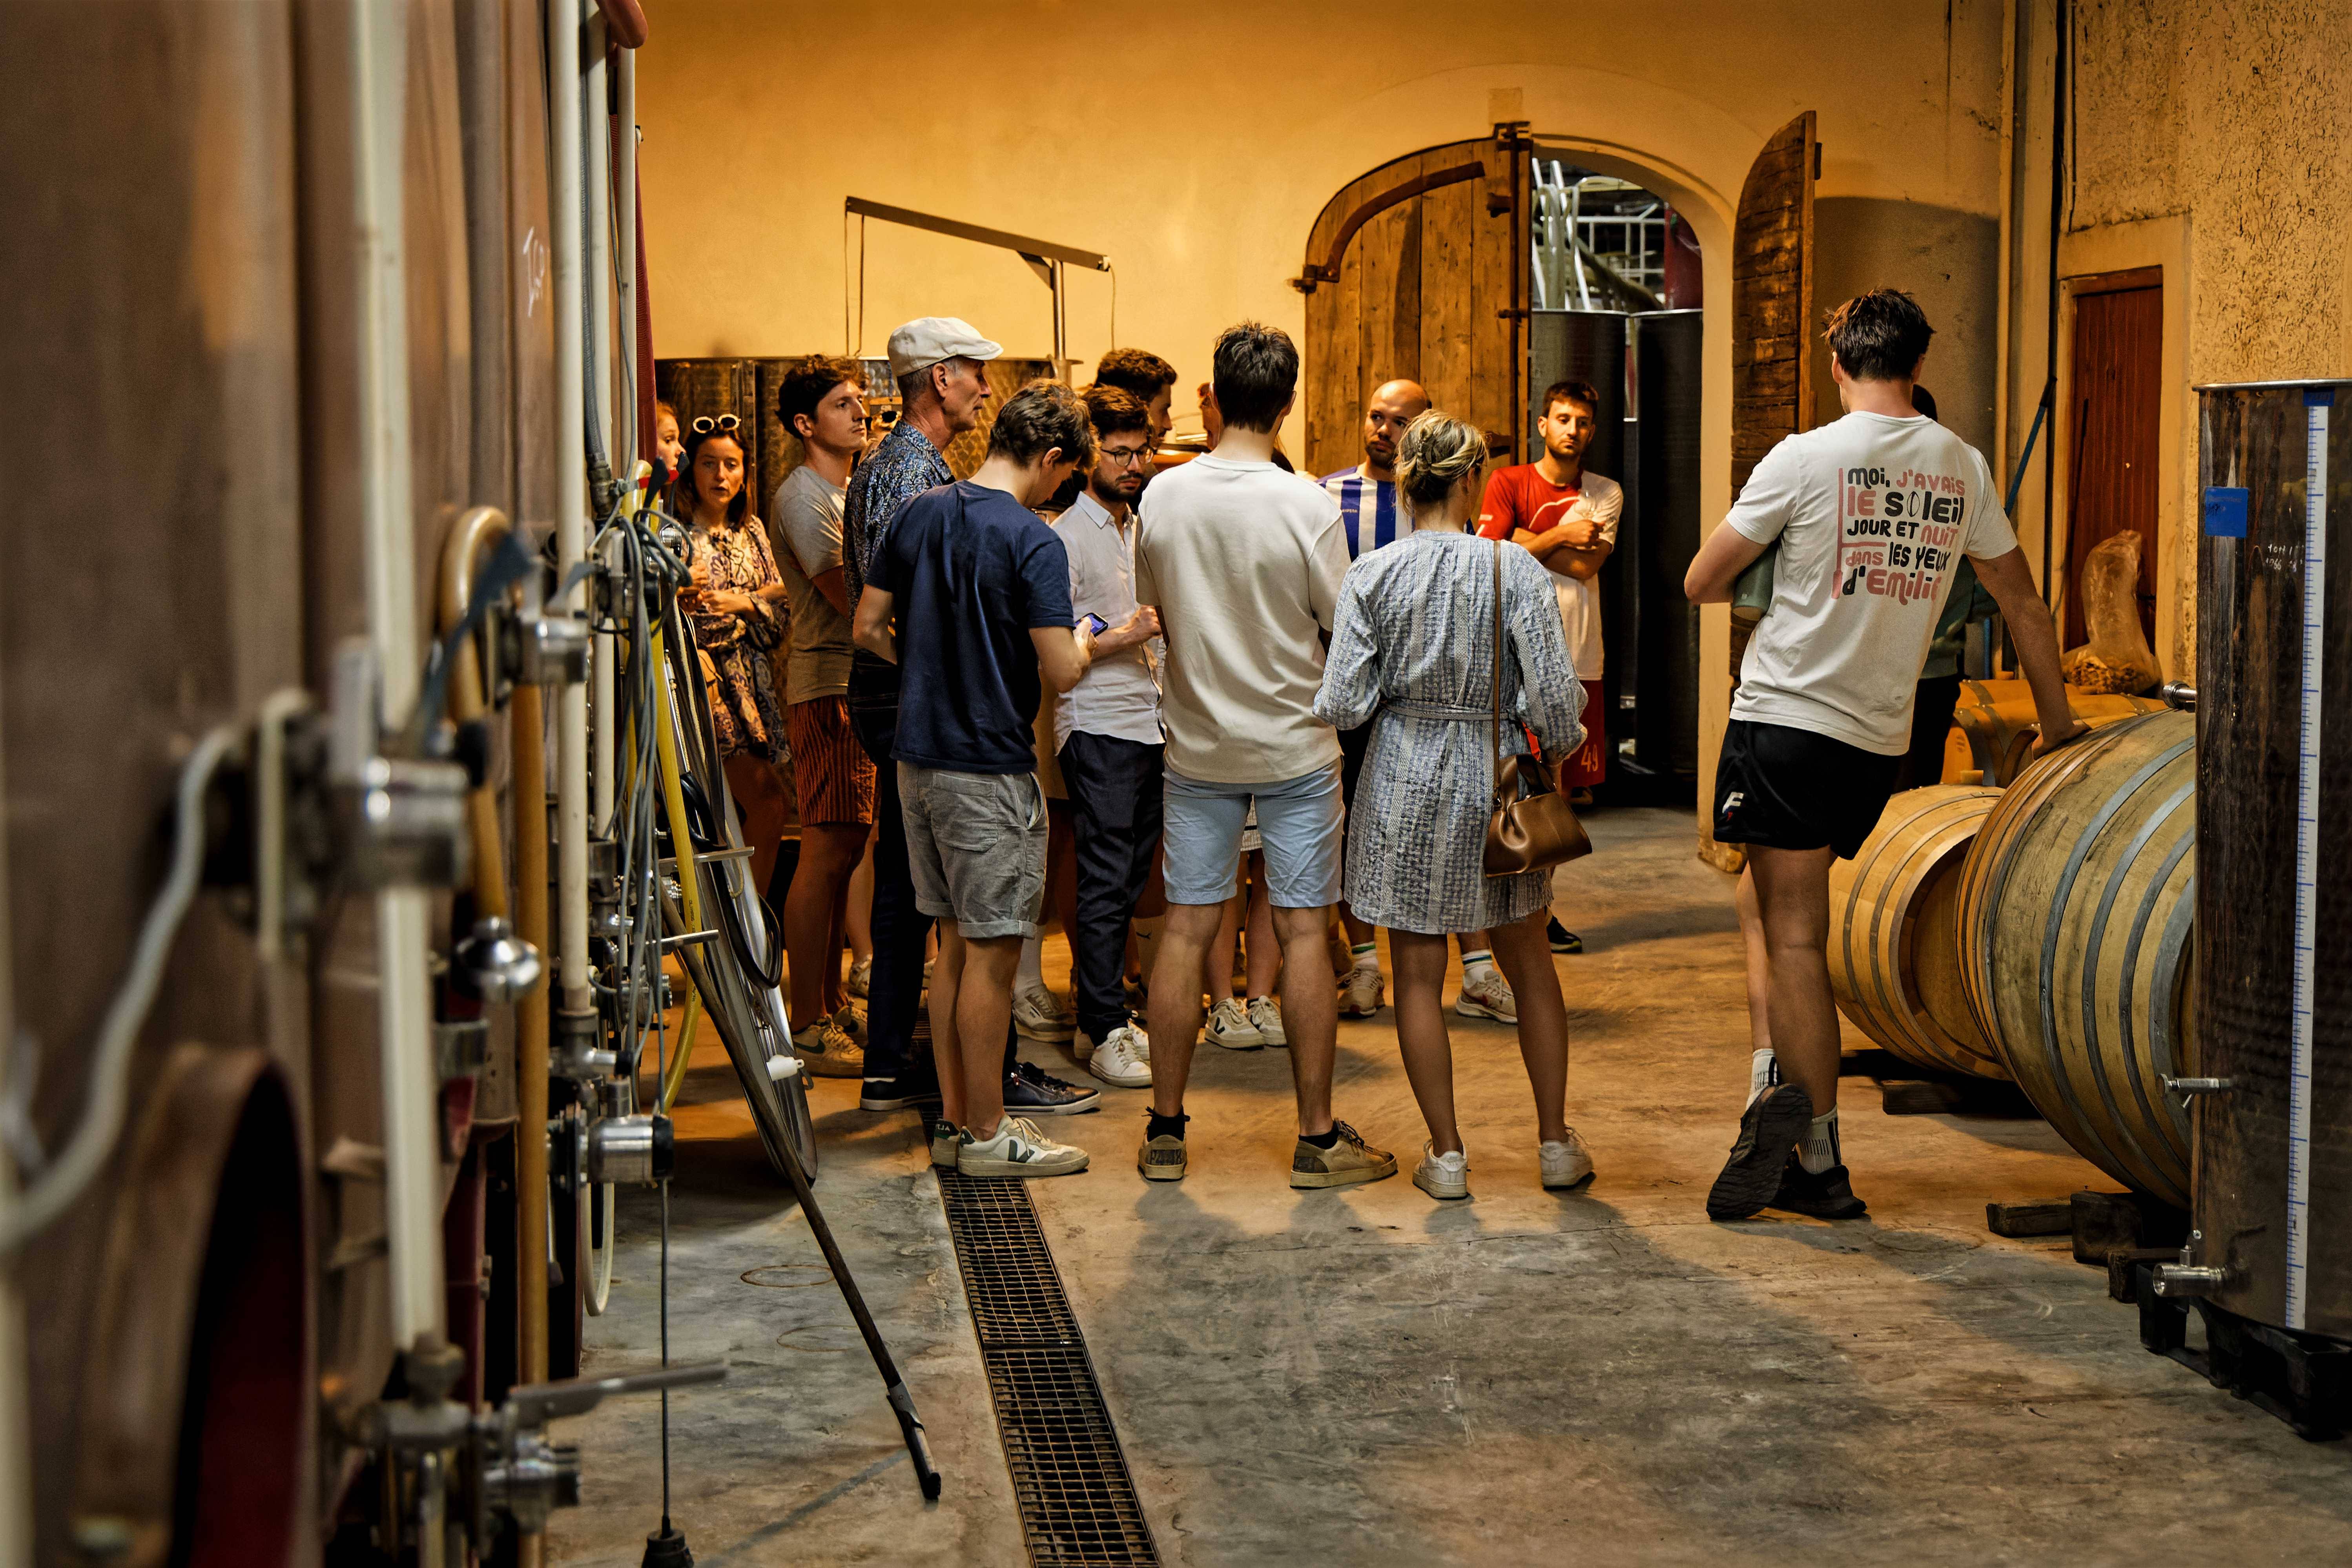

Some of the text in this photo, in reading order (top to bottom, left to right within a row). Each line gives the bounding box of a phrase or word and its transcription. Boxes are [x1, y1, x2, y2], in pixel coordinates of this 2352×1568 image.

[1847, 519, 1891, 537] JOUR
[1896, 521, 1920, 540] ET
[1915, 547, 1951, 572] YEUX
[1581, 743, 1598, 773] 49
